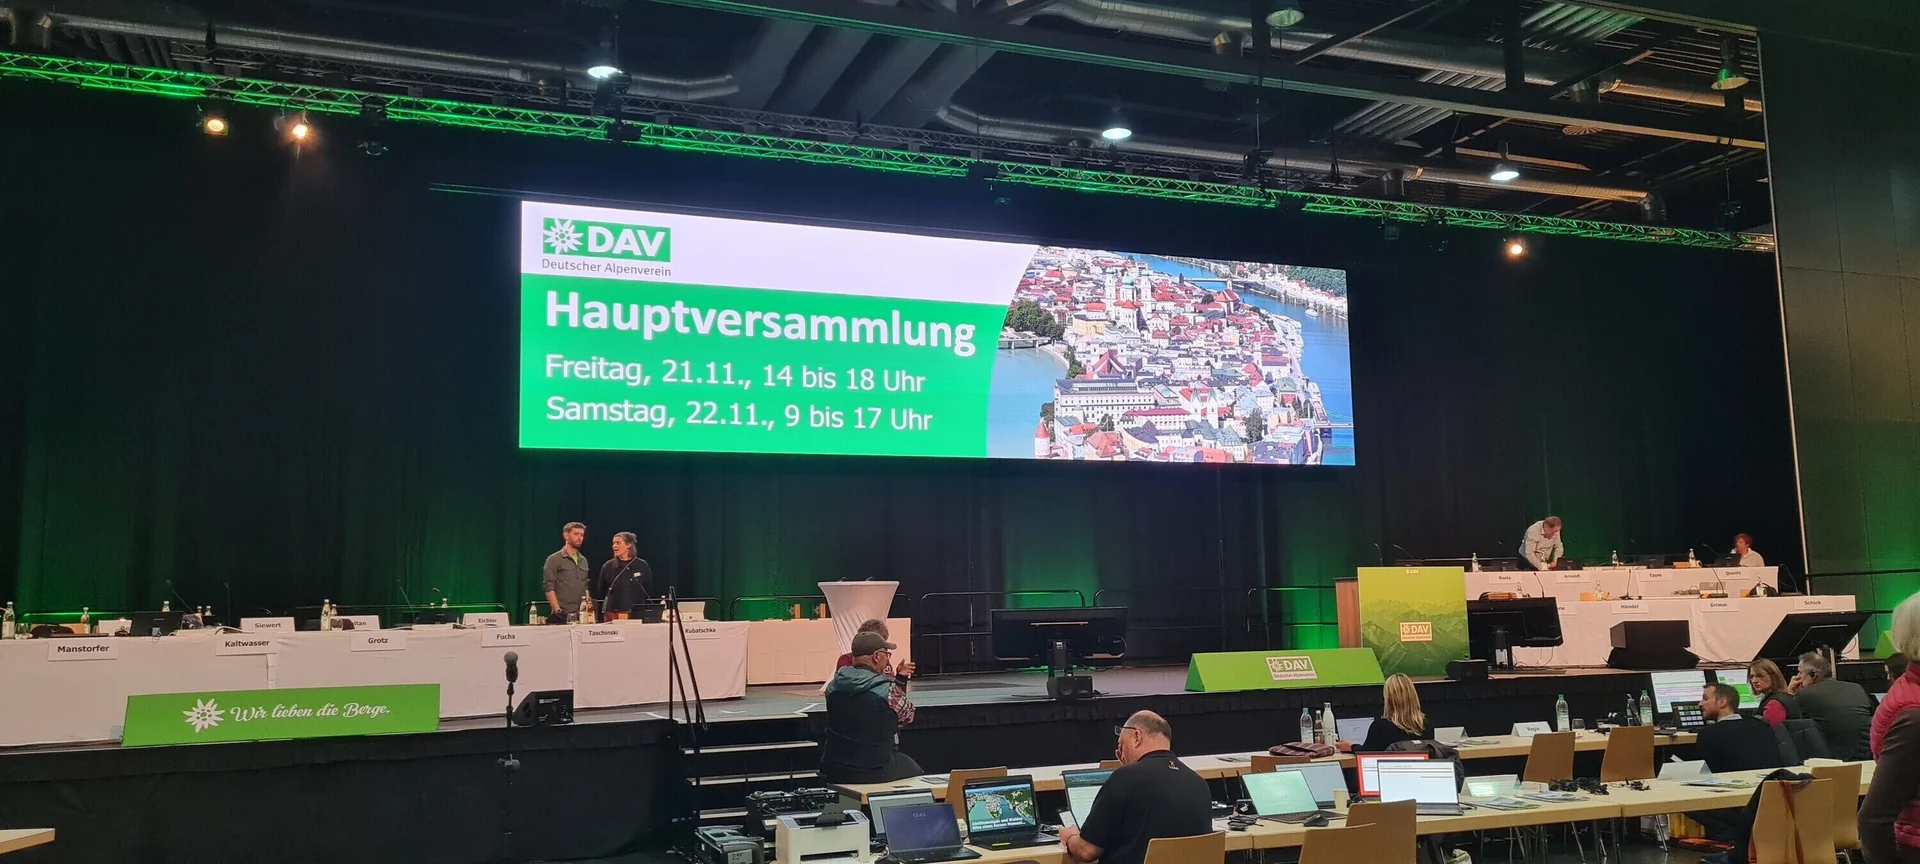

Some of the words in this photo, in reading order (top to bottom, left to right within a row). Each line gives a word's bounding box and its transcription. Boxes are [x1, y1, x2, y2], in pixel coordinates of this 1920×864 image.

[587, 225, 666, 258] DAV
[541, 258, 601, 274] Deutscher
[604, 261, 672, 277] Alpenverein
[546, 291, 976, 356] Hauptversammlung
[545, 355, 651, 387] Freitag,
[661, 358, 752, 390] 21.11.,
[762, 365, 793, 387] 14
[803, 364, 836, 389] bis
[846, 368, 875, 390] 18
[883, 369, 926, 393] Uhr
[545, 395, 676, 429] Samstag,
[685, 400, 775, 431] 22.11.,
[784, 405, 801, 427] 9
[809, 404, 845, 429] bis
[854, 407, 882, 430] 17
[890, 408, 934, 431] Uhr
[1412, 625, 1428, 633] DAV
[57, 645, 110, 653] Manstorfer
[1283, 660, 1308, 670] DAV
[230, 704, 268, 723] Wir
[272, 704, 313, 718] lieben
[317, 702, 340, 717] die
[344, 702, 390, 719] Berge.
